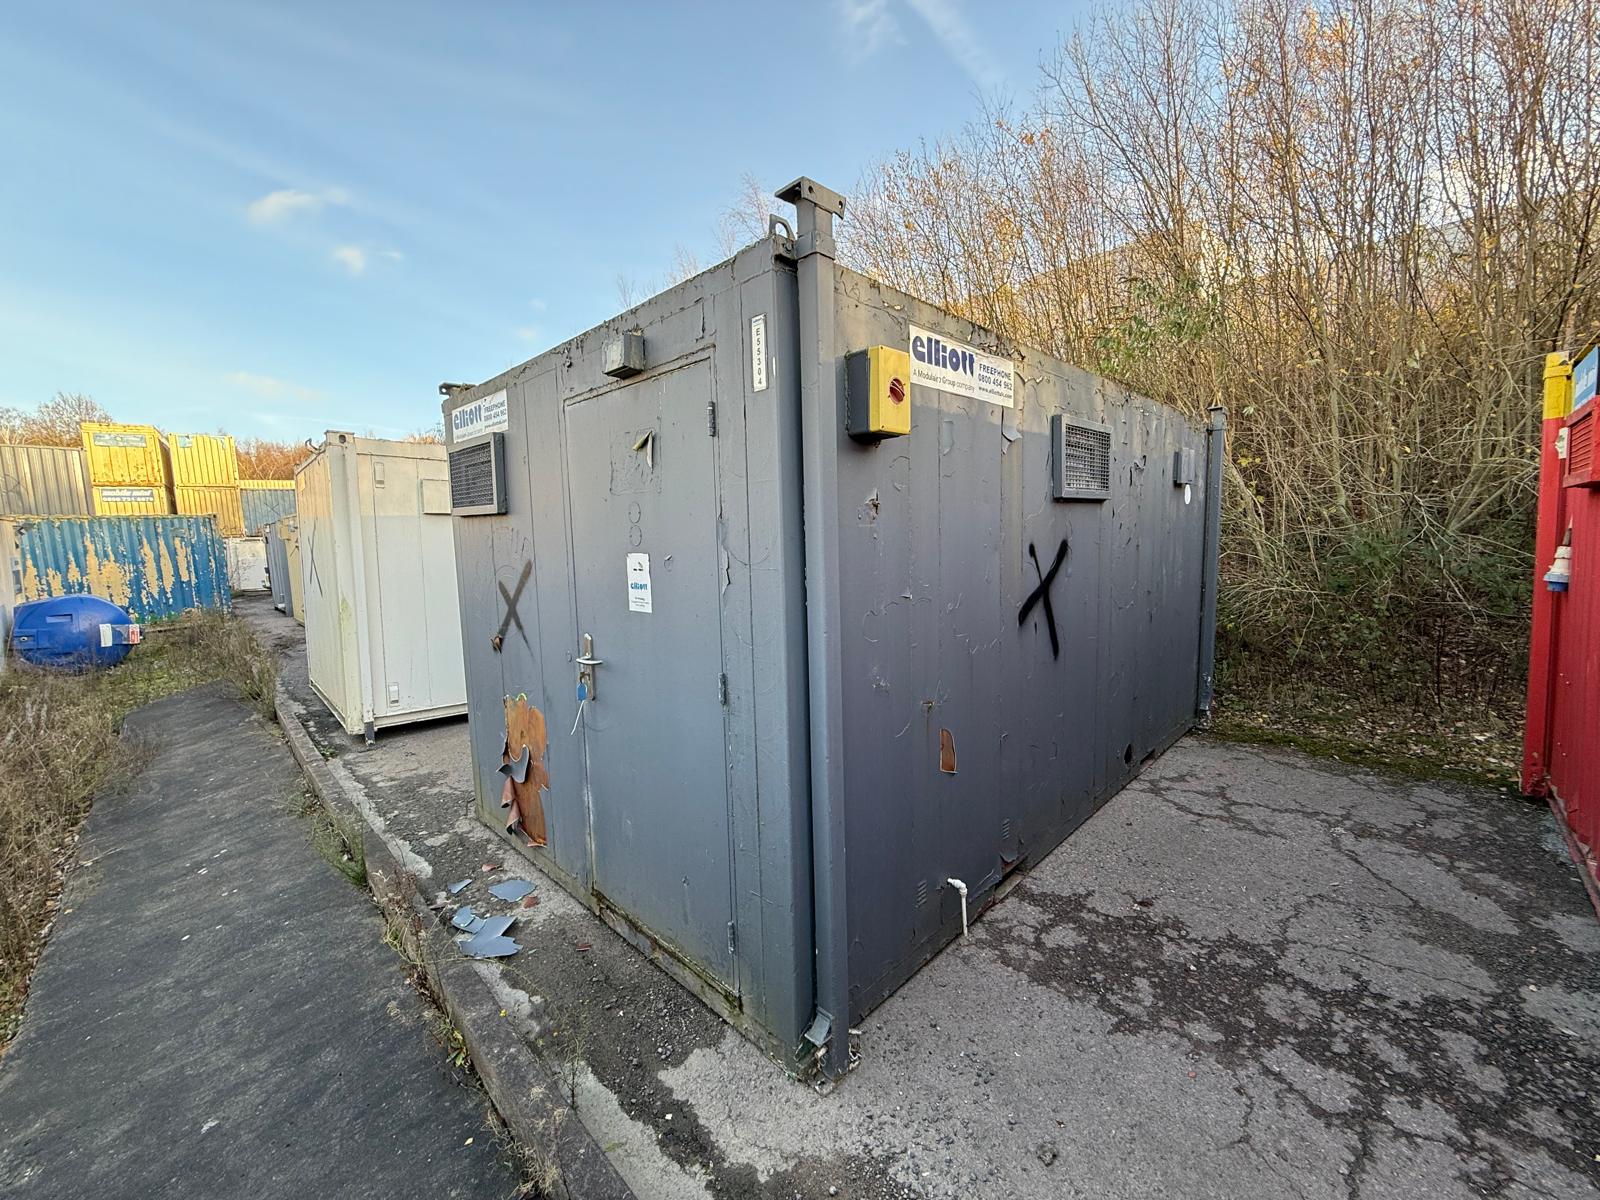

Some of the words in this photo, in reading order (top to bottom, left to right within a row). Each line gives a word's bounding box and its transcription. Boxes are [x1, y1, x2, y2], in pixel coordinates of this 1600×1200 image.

[912, 335, 975, 377] elliott
[978, 373, 992, 385] 0800
[992, 377, 1002, 388] 454
[979, 363, 1012, 381] FREEPHONE
[453, 404, 482, 430] elliott
